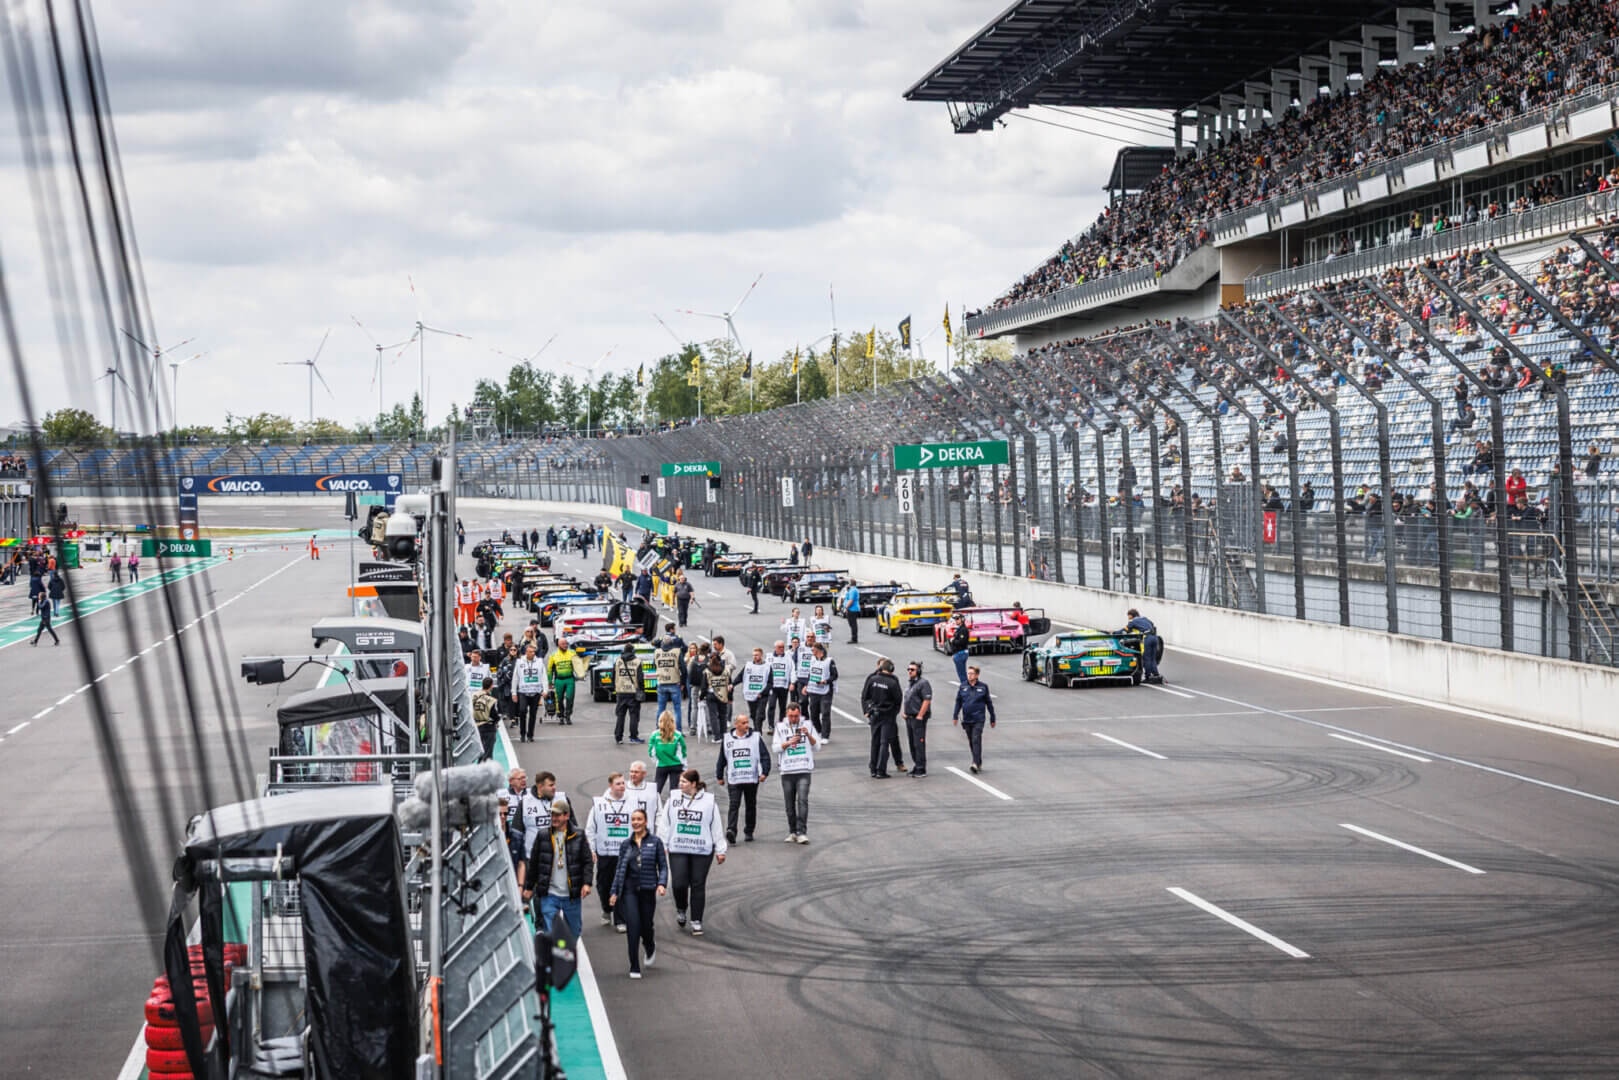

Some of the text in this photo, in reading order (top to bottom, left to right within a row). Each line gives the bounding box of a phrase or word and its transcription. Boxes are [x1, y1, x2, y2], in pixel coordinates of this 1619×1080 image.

[938, 446, 985, 461] DEKRA
[683, 464, 708, 472] DEKRA
[901, 478, 910, 512] 200
[170, 543, 196, 553] DEKRA
[356, 636, 395, 645] GT3
[527, 806, 538, 815] 24
[679, 811, 701, 821] DTM
